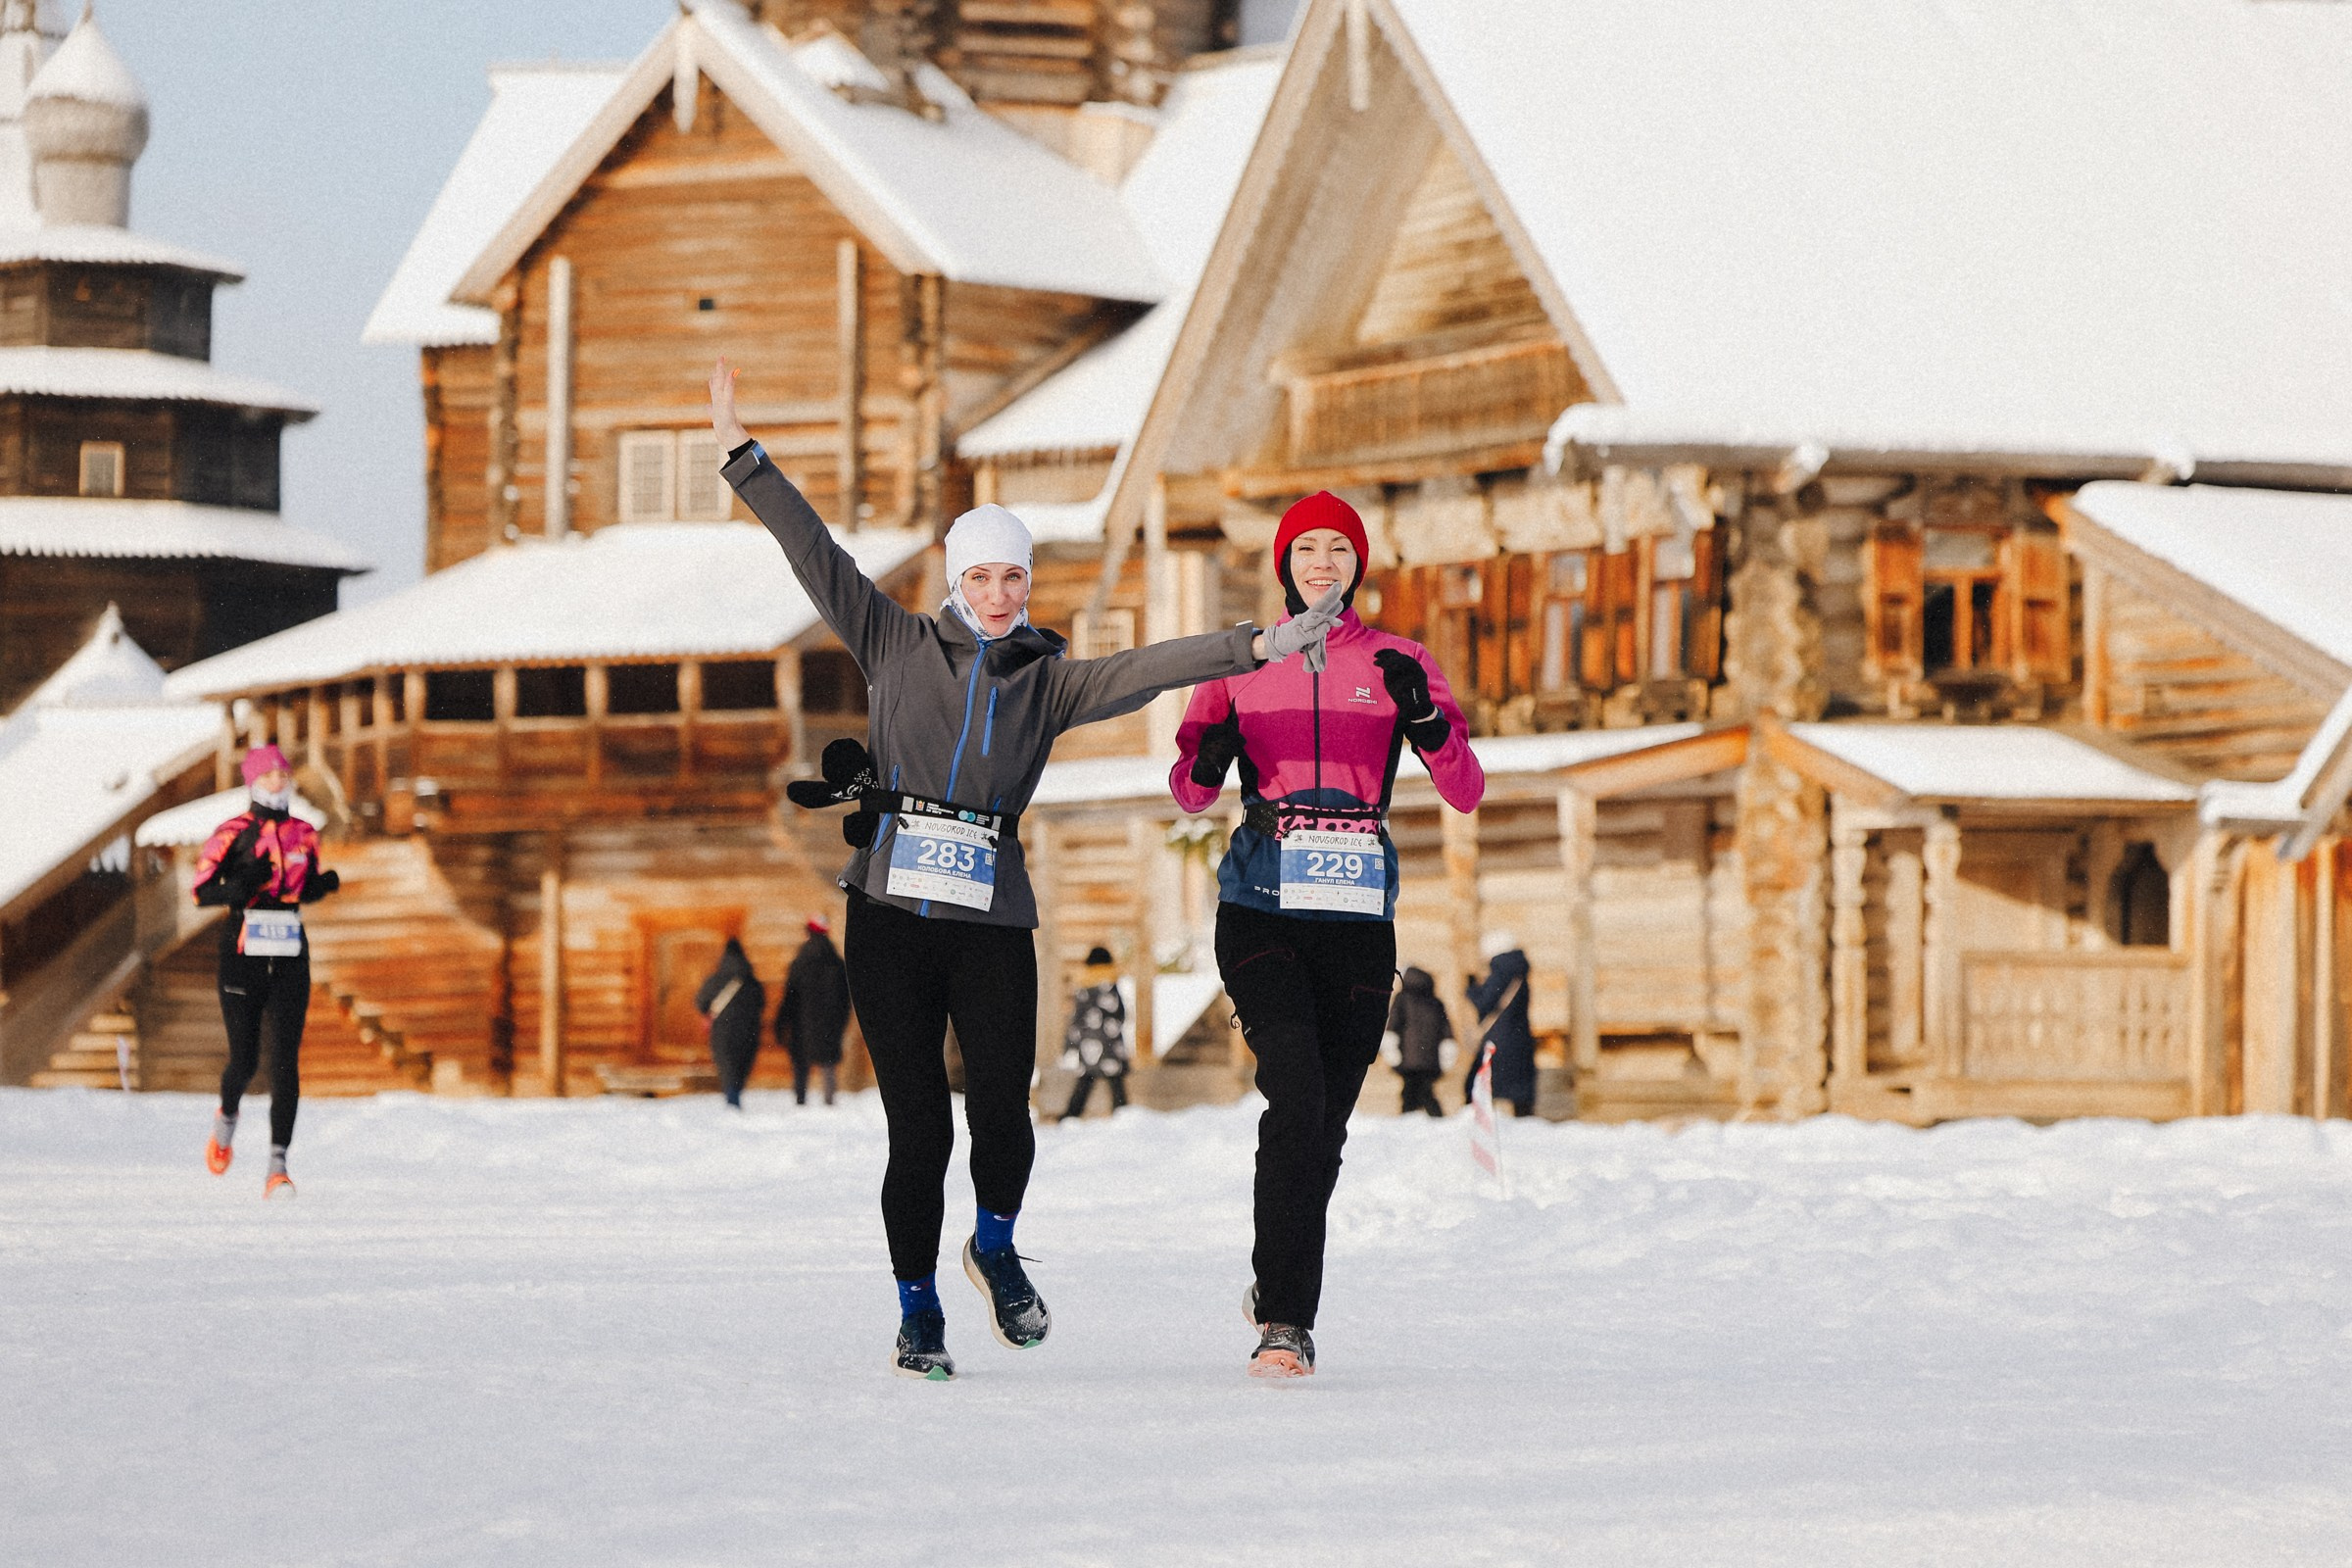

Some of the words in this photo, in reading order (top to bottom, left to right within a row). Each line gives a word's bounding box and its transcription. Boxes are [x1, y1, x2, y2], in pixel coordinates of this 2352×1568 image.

[924, 822, 965, 835] NOVGOROD
[966, 828, 978, 839] ICE
[1308, 835, 1348, 845] NOVGOROD
[1350, 838, 1362, 847] ICE
[917, 840, 975, 872] 283
[917, 865, 952, 875] КОЛОБОВА
[1306, 852, 1363, 879] 229
